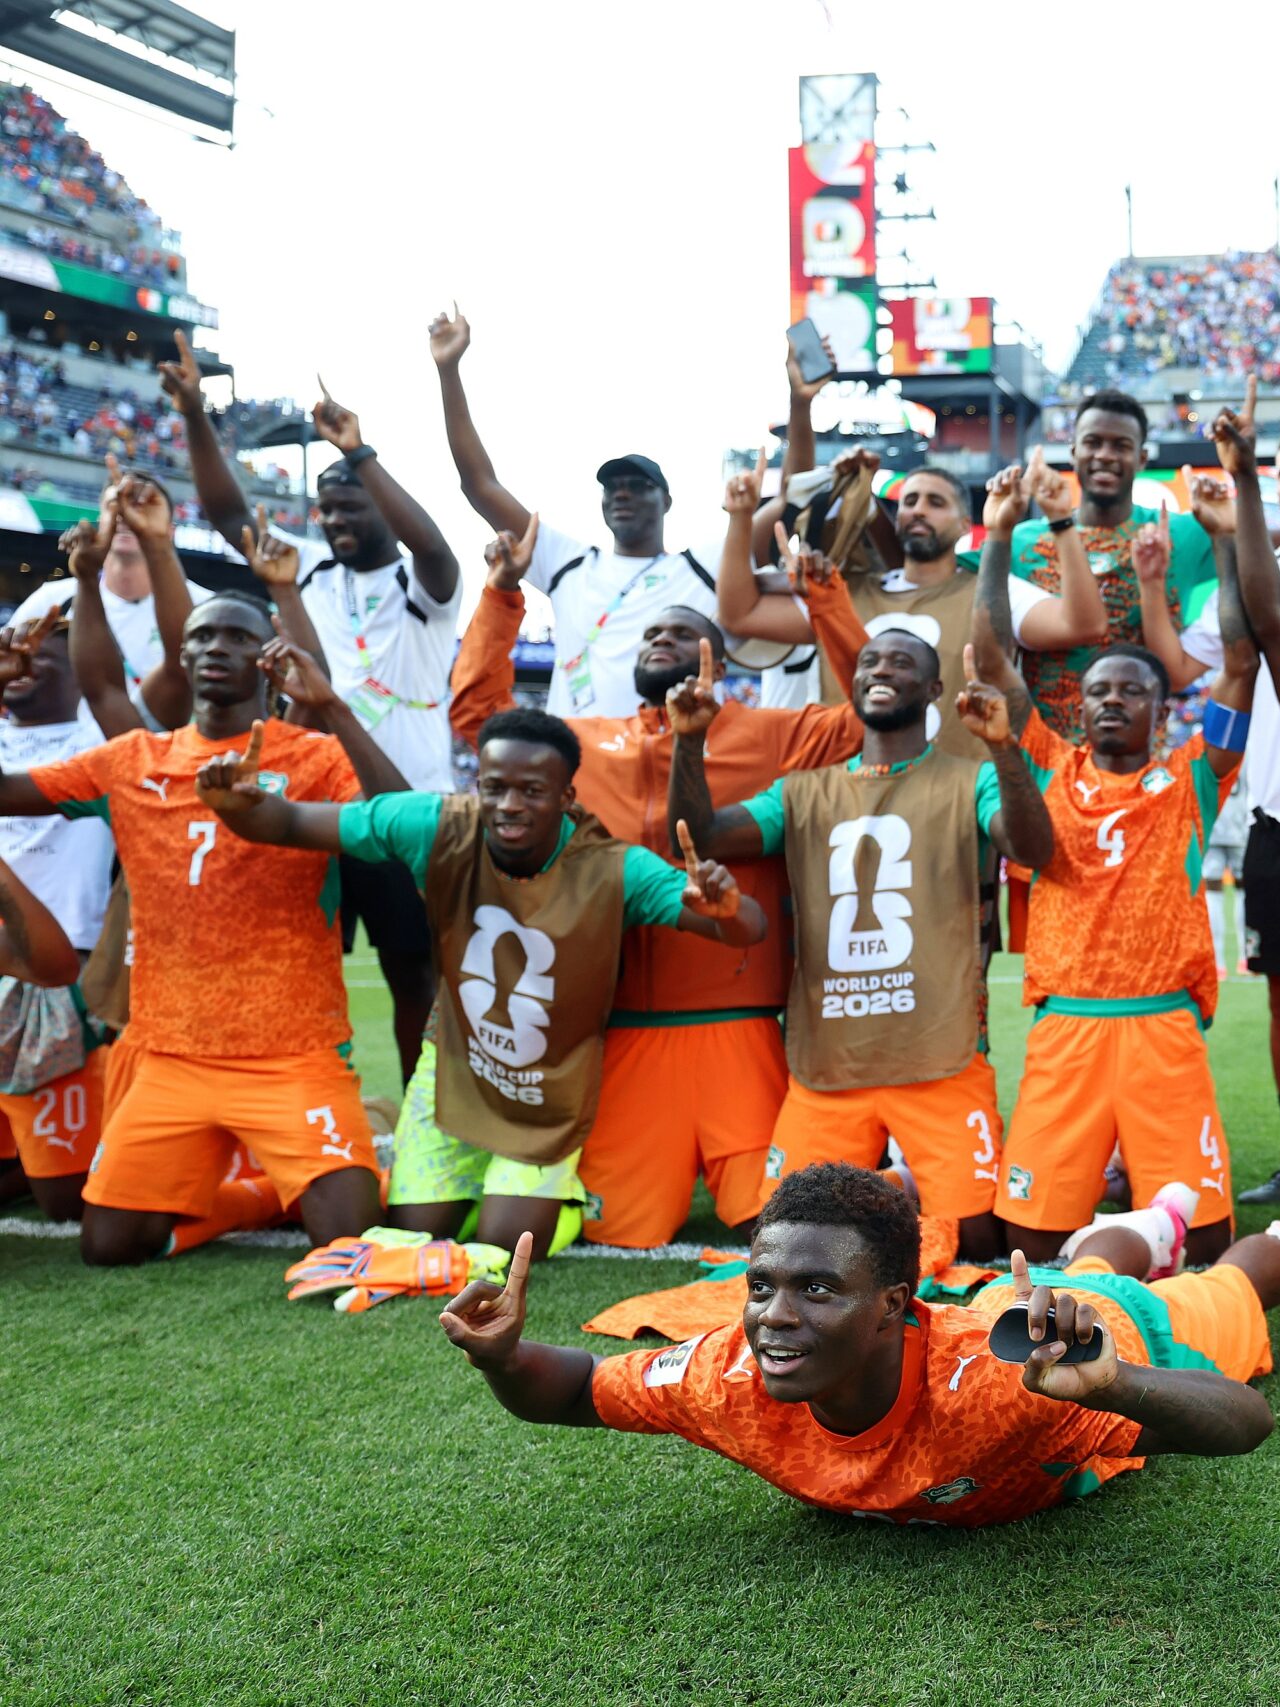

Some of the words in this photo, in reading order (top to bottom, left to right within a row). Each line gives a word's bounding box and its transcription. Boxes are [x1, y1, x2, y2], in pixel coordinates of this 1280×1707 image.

[187, 821, 217, 886] 7
[1096, 808, 1128, 868] 4
[848, 939, 889, 957] FIFA
[822, 988, 916, 1019] 2026
[823, 973, 881, 994] WORLD
[882, 971, 915, 989] CUP
[479, 1026, 517, 1054] FIFA
[468, 1051, 545, 1106] 2026
[507, 1070, 545, 1086] CUP
[32, 1084, 87, 1136] 20
[966, 1109, 996, 1165] 3
[1199, 1115, 1223, 1171] 4
